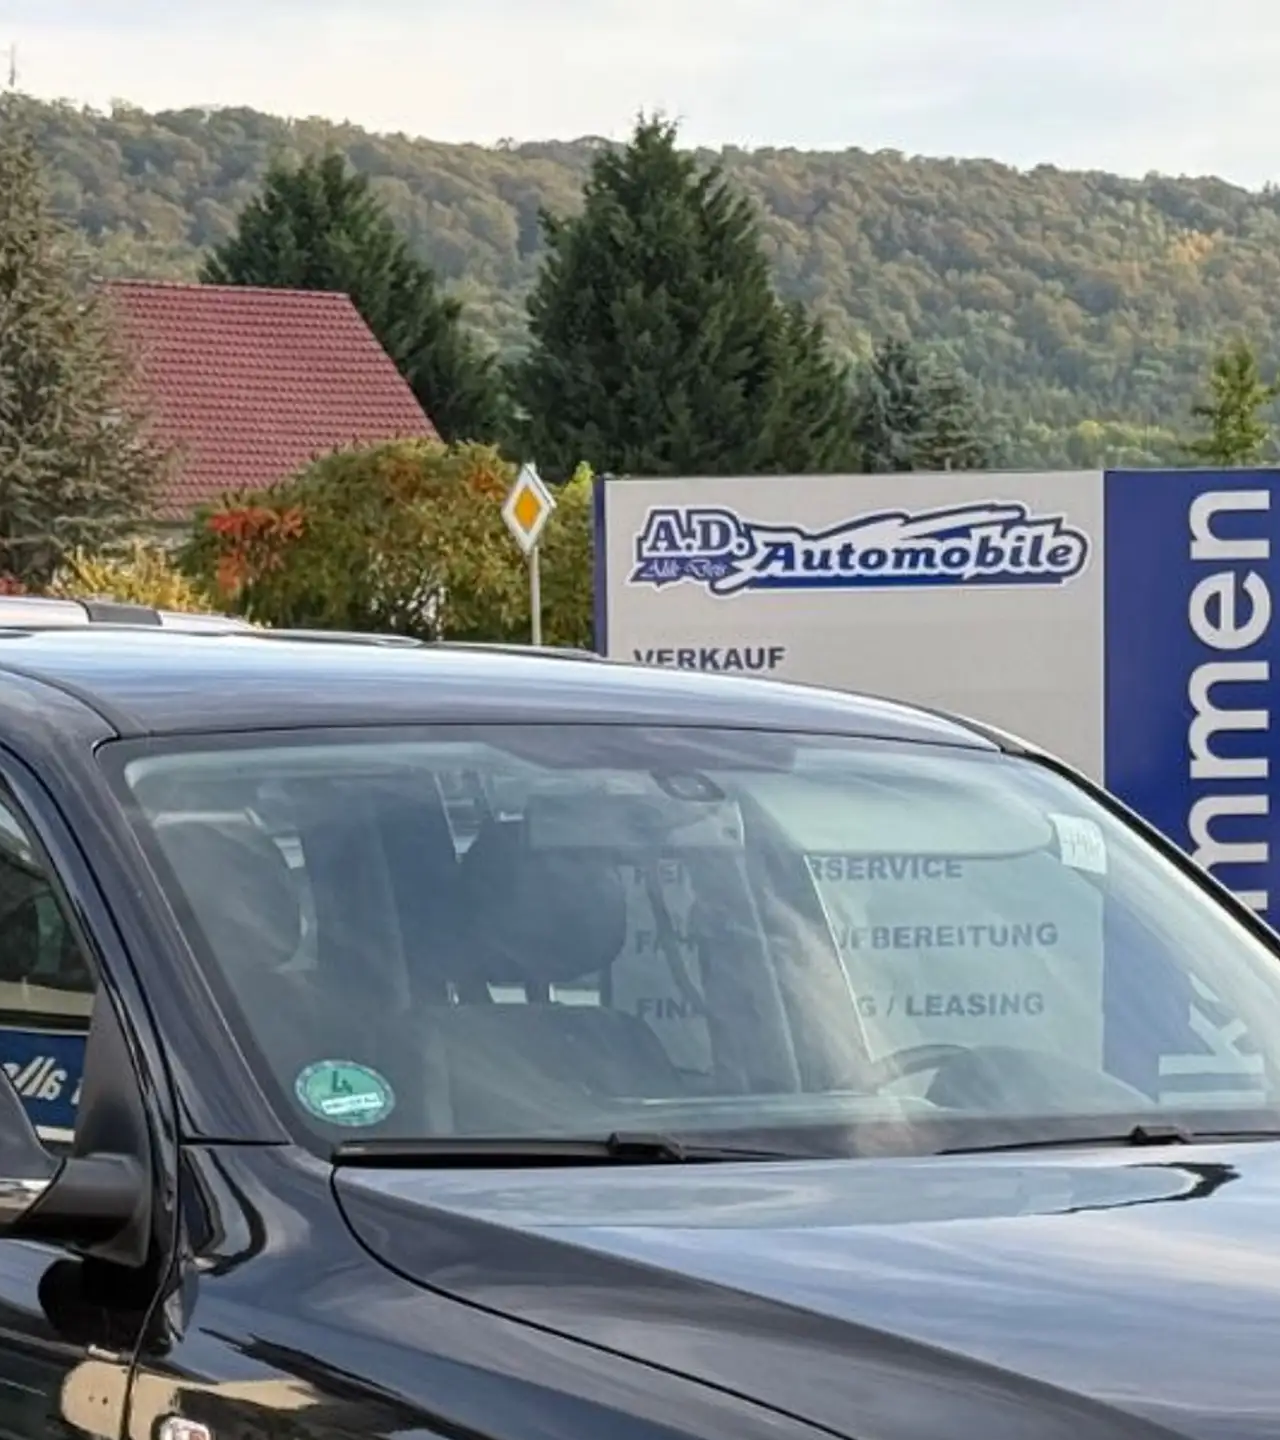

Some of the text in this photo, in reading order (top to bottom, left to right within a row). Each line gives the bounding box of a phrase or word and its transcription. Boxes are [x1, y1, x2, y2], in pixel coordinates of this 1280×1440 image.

[647, 519, 1074, 575] A.D. Automobile
[633, 647, 785, 671] VERKAUF
[904, 992, 1045, 1018] LEASING
